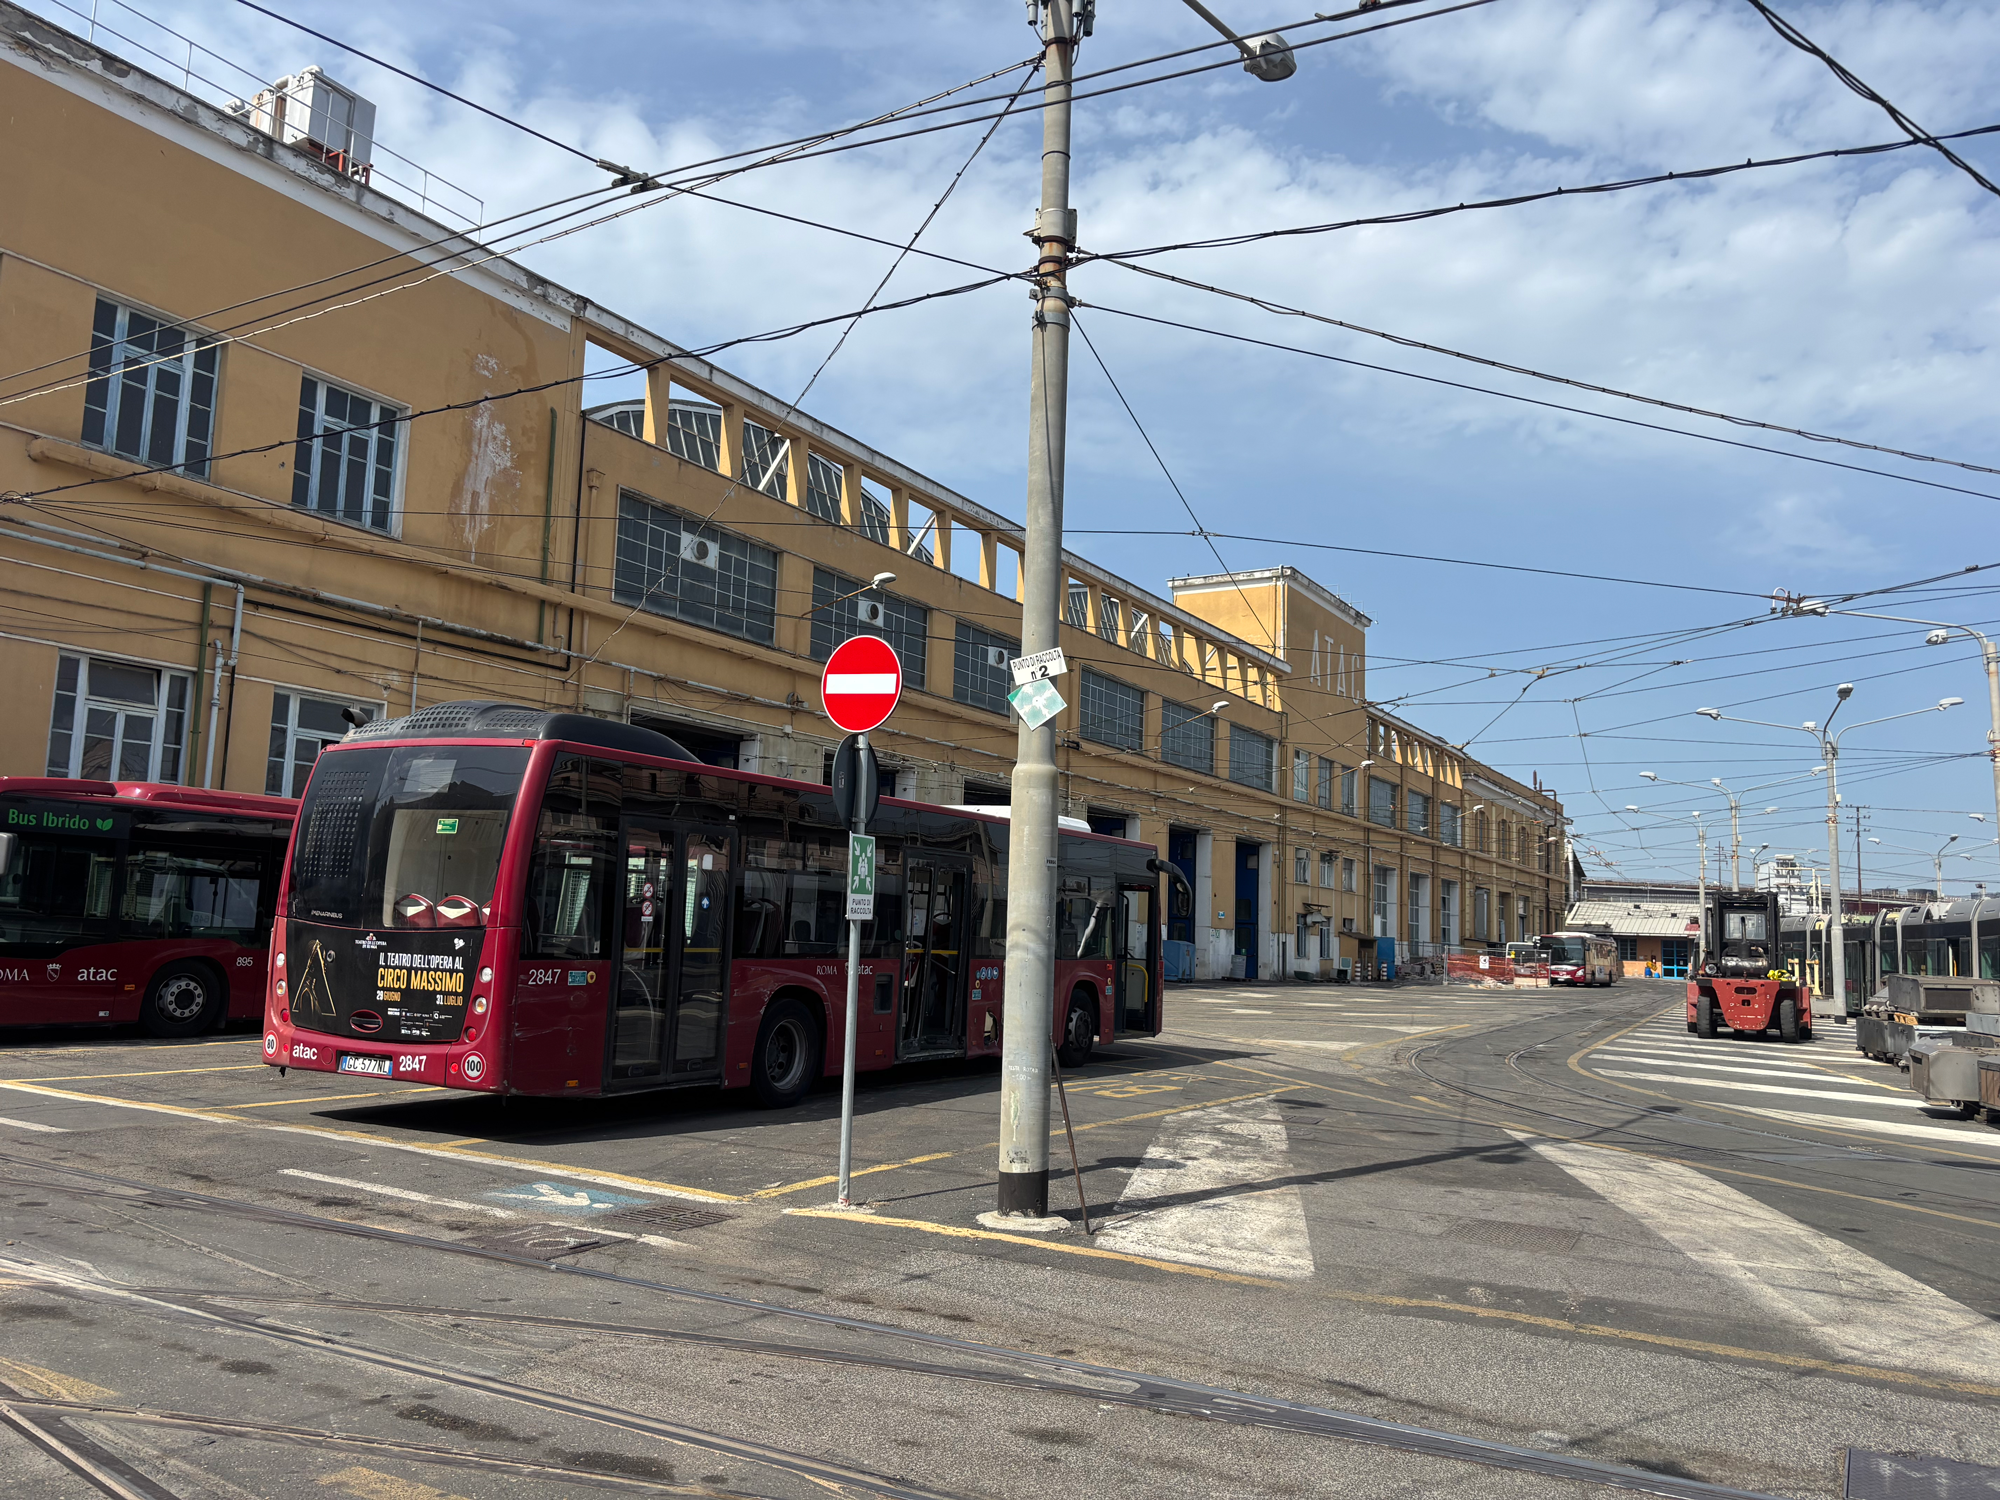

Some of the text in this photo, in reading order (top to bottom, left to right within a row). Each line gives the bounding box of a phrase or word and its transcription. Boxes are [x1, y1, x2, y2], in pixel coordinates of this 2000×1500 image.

[1012, 649, 1062, 671] PUNTO DI RACCOLTA
[1310, 629, 1360, 705] ATAC
[8, 808, 89, 830] Bus Ibrido
[852, 898, 866, 906] PUNTO
[850, 907, 872, 915] RACCOLTA
[236, 956, 254, 967] 895
[379, 952, 464, 970] IL TEATRO DELL'OPERA AL
[77, 966, 118, 981] atac
[528, 968, 561, 985] 2847
[816, 965, 838, 975] ROMA
[377, 967, 464, 993] CIRCO MASSIMO
[444, 995, 463, 1006] LUGLIO
[267, 1039, 275, 1050] 80
[292, 1043, 318, 1060] atac
[399, 1055, 427, 1072] 2847
[466, 1059, 482, 1073] 100
